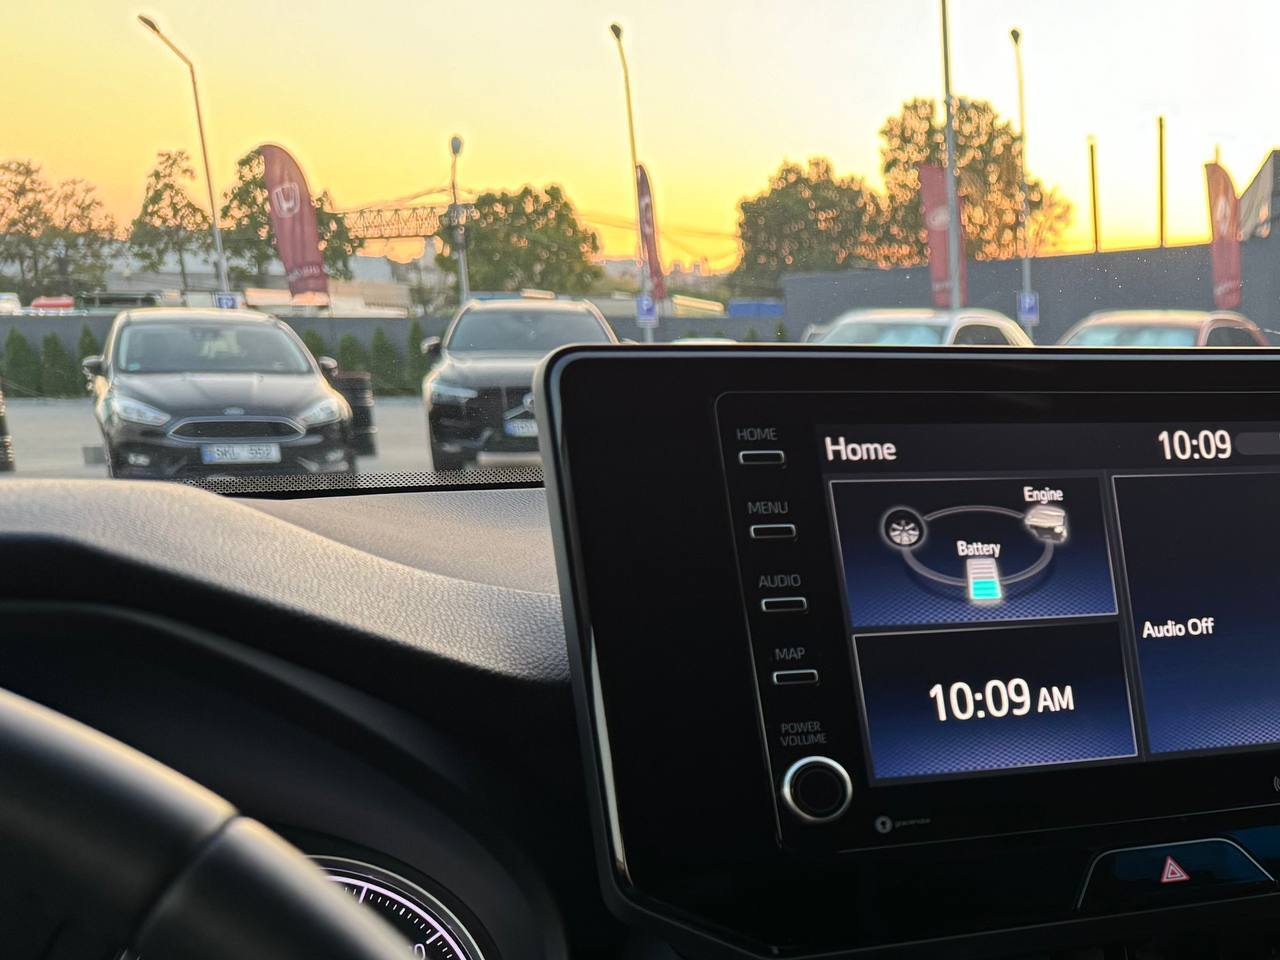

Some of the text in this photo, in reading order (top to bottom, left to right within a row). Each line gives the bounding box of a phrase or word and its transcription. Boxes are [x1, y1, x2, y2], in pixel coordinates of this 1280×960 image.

[737, 427, 778, 441] HOME
[824, 436, 897, 462] Home
[1158, 430, 1232, 460] 10:09
[1023, 486, 1064, 505] Engine
[748, 501, 789, 514] MENU
[956, 540, 1001, 558] Battery
[759, 574, 802, 588] AUDIO
[1142, 617, 1215, 639] Audio Off
[775, 647, 806, 661] MAP
[928, 677, 1075, 722] 10:09 AM
[781, 720, 822, 734] POWER
[779, 732, 828, 747] VOLUME
